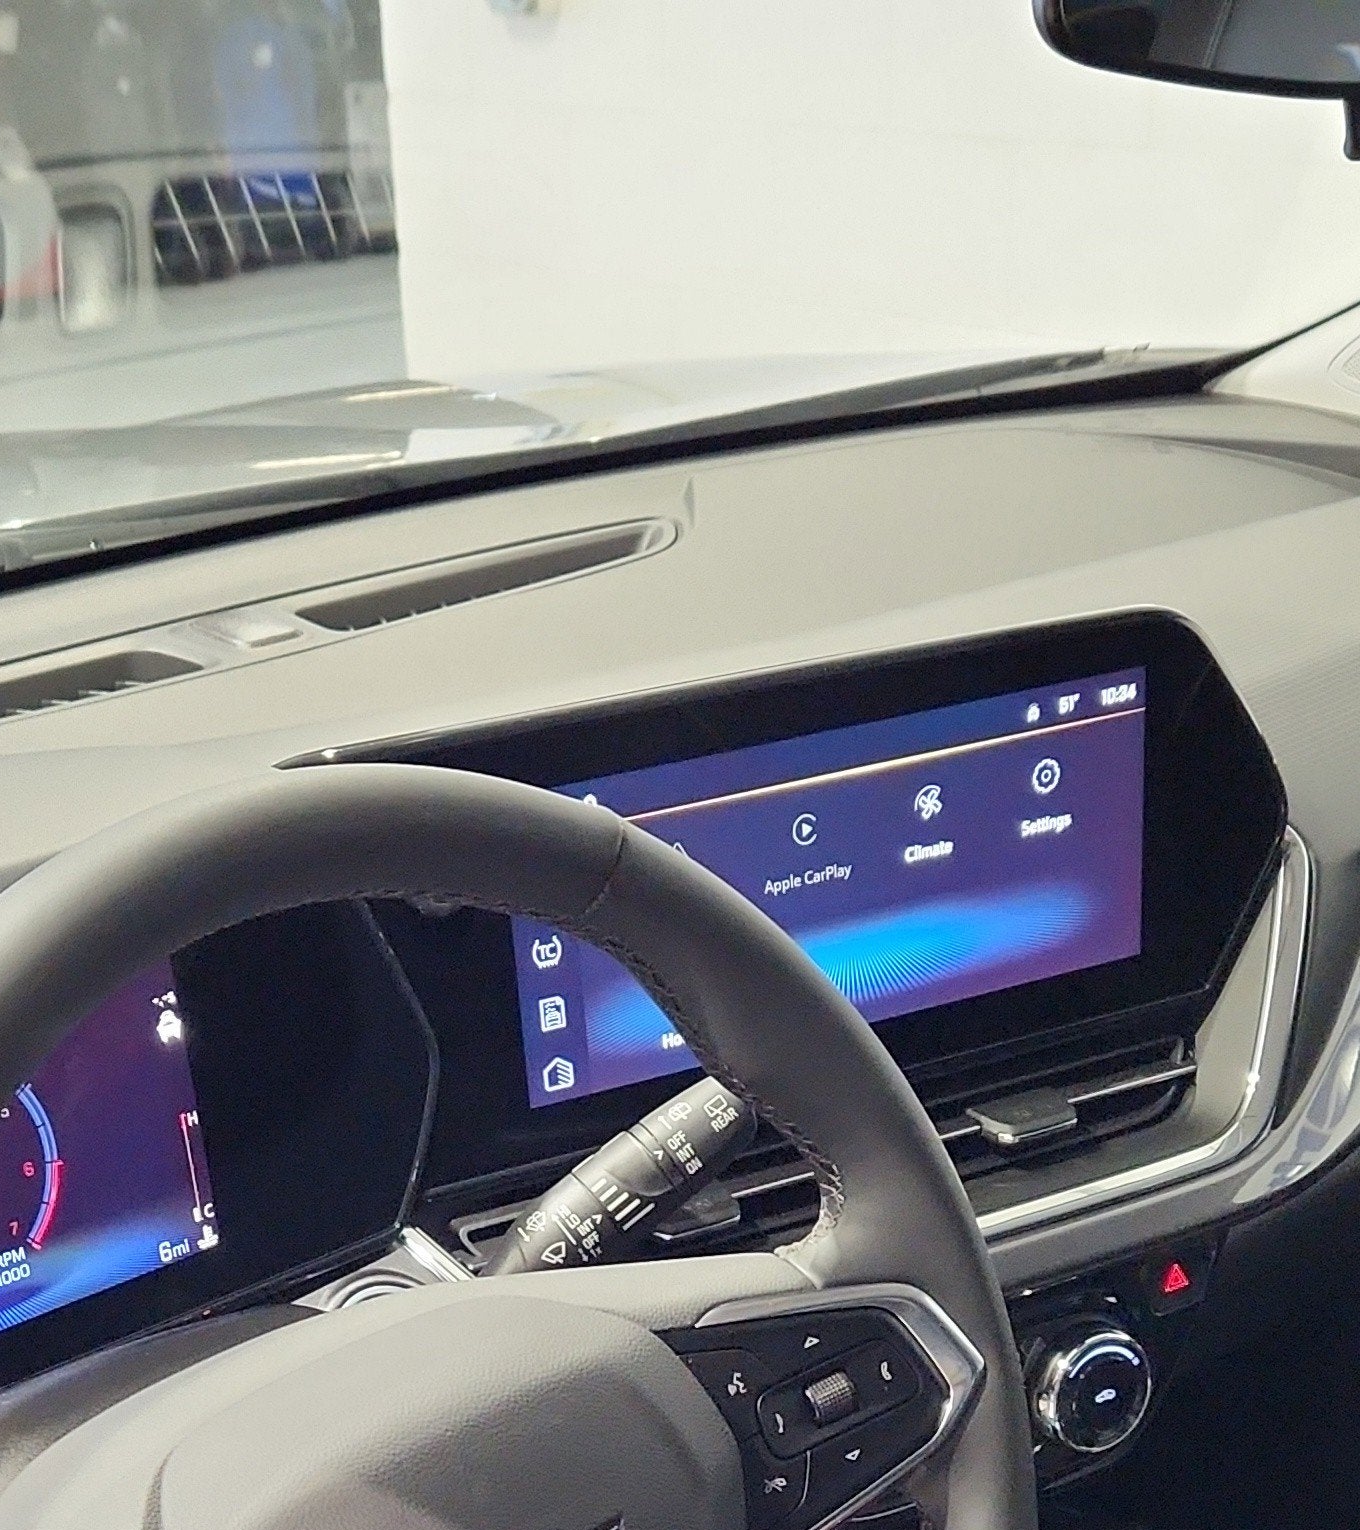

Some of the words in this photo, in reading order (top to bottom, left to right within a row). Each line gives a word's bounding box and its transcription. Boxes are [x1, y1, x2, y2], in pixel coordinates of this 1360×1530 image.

[1020, 812, 1073, 838] Settings
[904, 840, 955, 864] Climate
[763, 870, 803, 896] Apple
[803, 863, 853, 885] CarPlay
[661, 1032, 686, 1050] Ho
[186, 1110, 199, 1126] H
[710, 1107, 739, 1133] REAR
[667, 1130, 688, 1151] OFF
[676, 1142, 697, 1163] INT
[22, 1161, 35, 1177] 6
[685, 1159, 704, 1175] ON
[204, 1203, 216, 1218] C
[565, 1212, 581, 1229] LO
[9, 1221, 19, 1236] 7
[576, 1216, 594, 1236] INT
[582, 1229, 601, 1250] OFF
